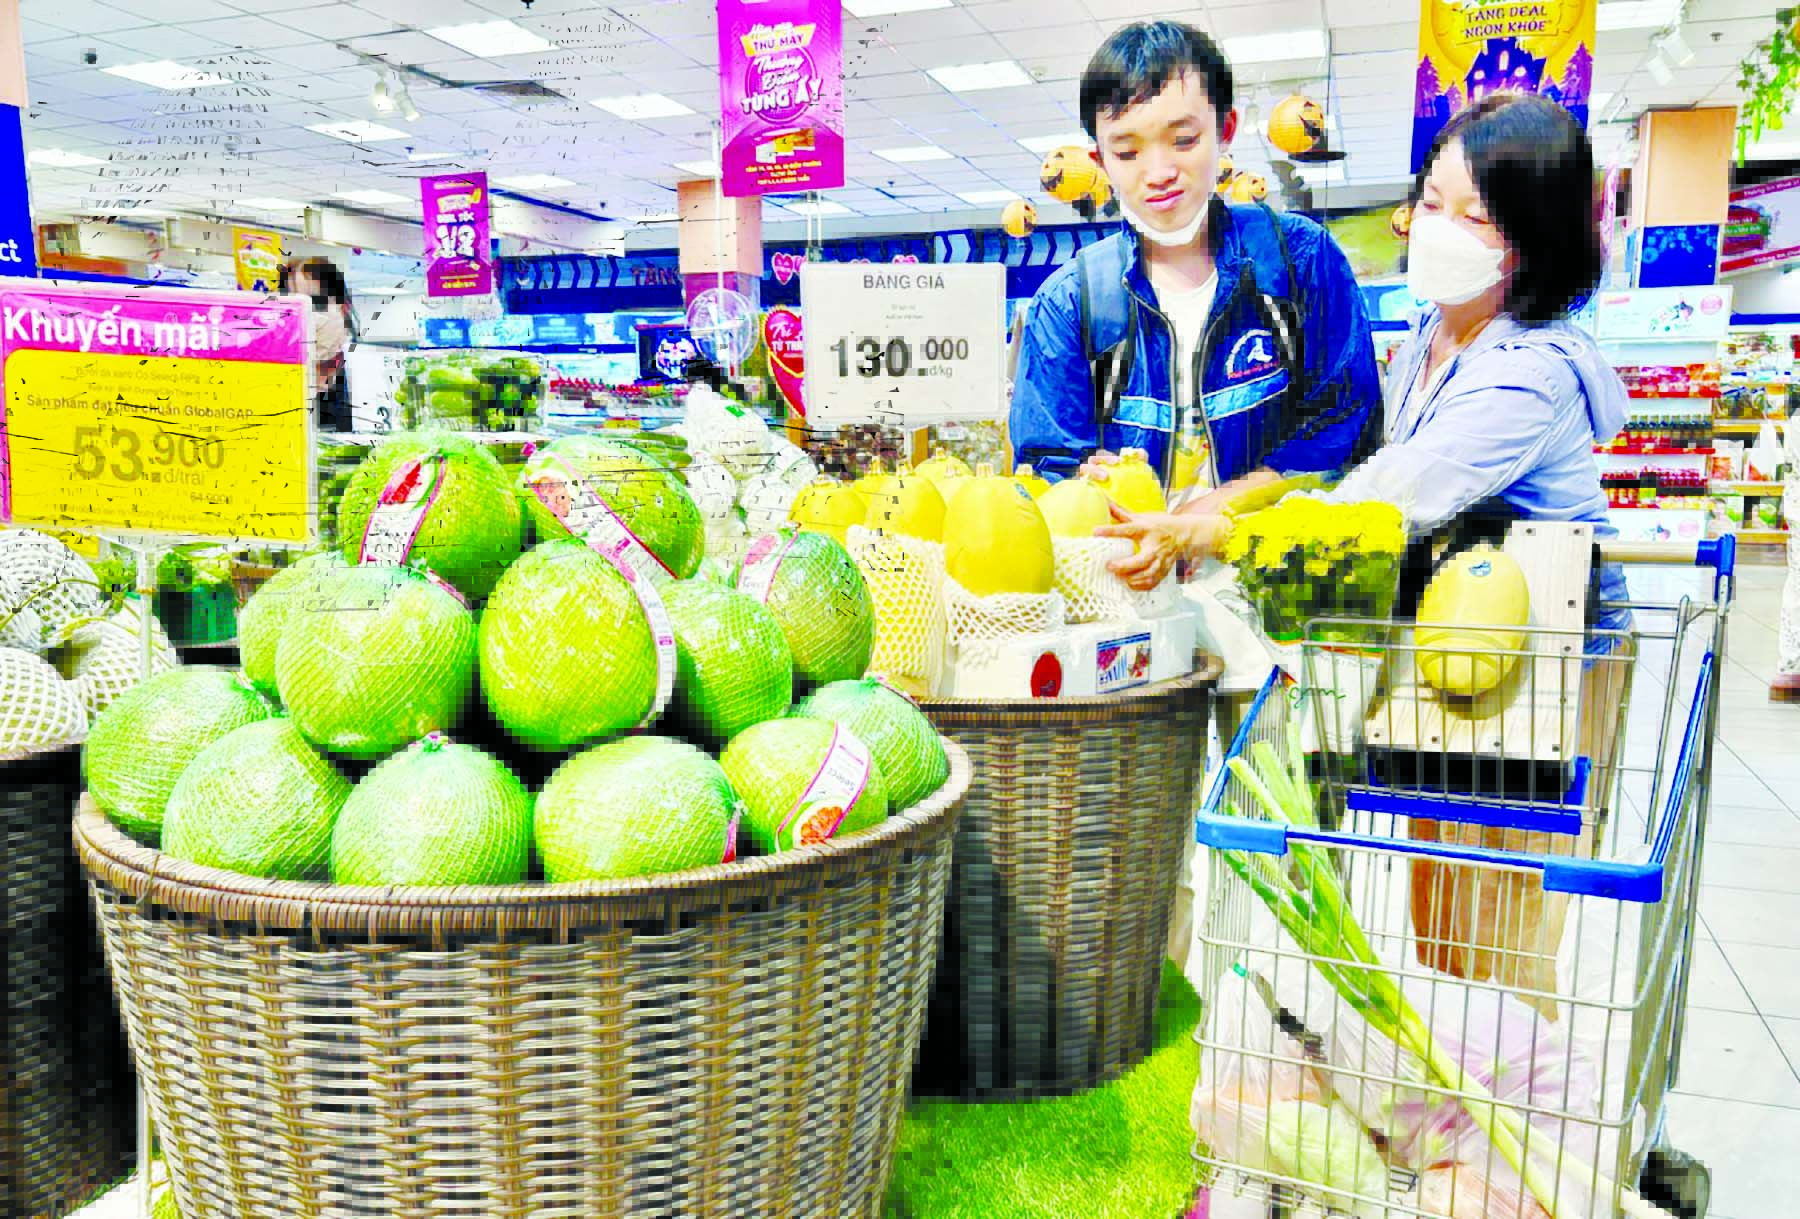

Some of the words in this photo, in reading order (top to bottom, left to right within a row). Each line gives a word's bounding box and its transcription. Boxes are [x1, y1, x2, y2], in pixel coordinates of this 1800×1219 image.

[1509, 5, 1547, 17] DEAL
[916, 271, 944, 289] GIÁ
[3, 304, 142, 352] Khuyến
[153, 312, 221, 352] mãi
